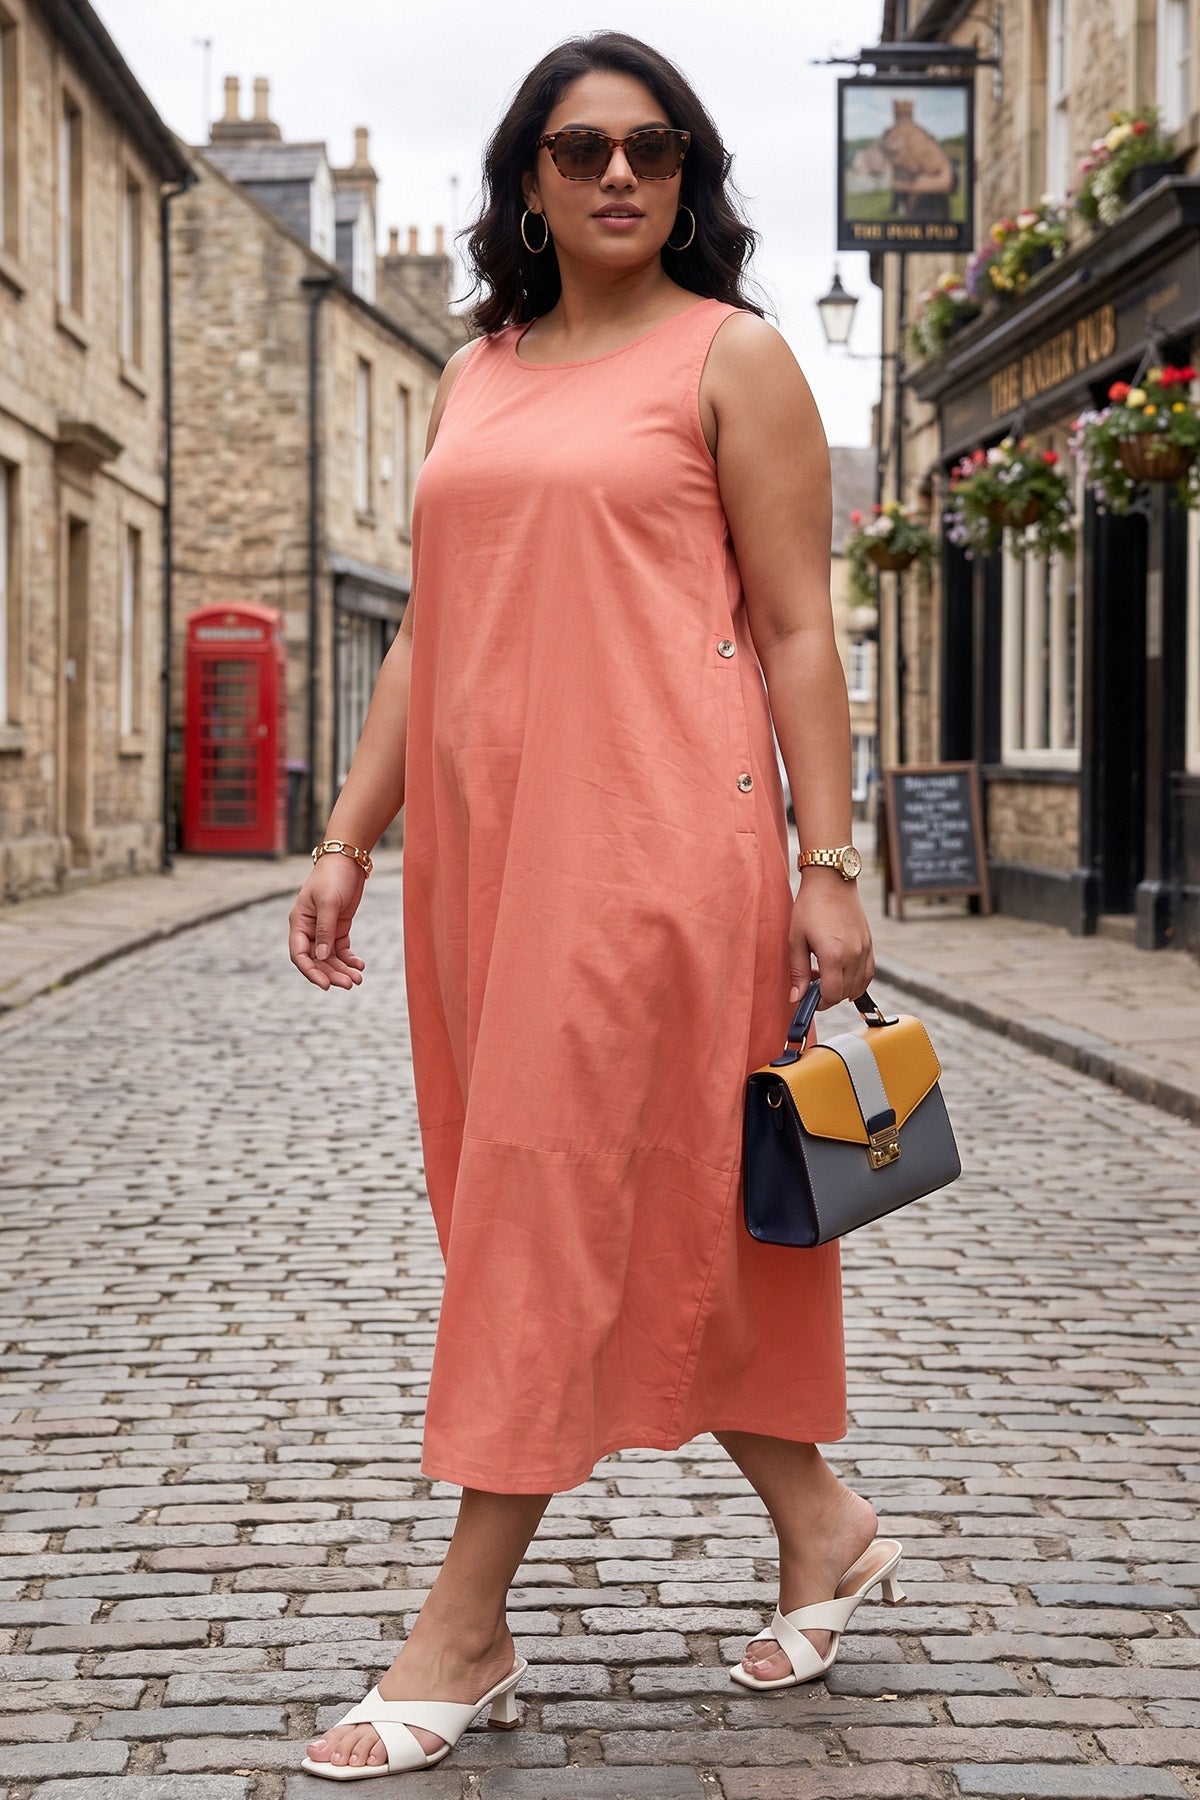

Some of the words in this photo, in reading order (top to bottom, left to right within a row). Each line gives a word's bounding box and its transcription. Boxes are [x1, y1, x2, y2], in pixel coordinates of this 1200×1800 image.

[852, 223, 881, 239] THE
[989, 361, 1020, 419] THE
[1077, 304, 1116, 370] PUB
